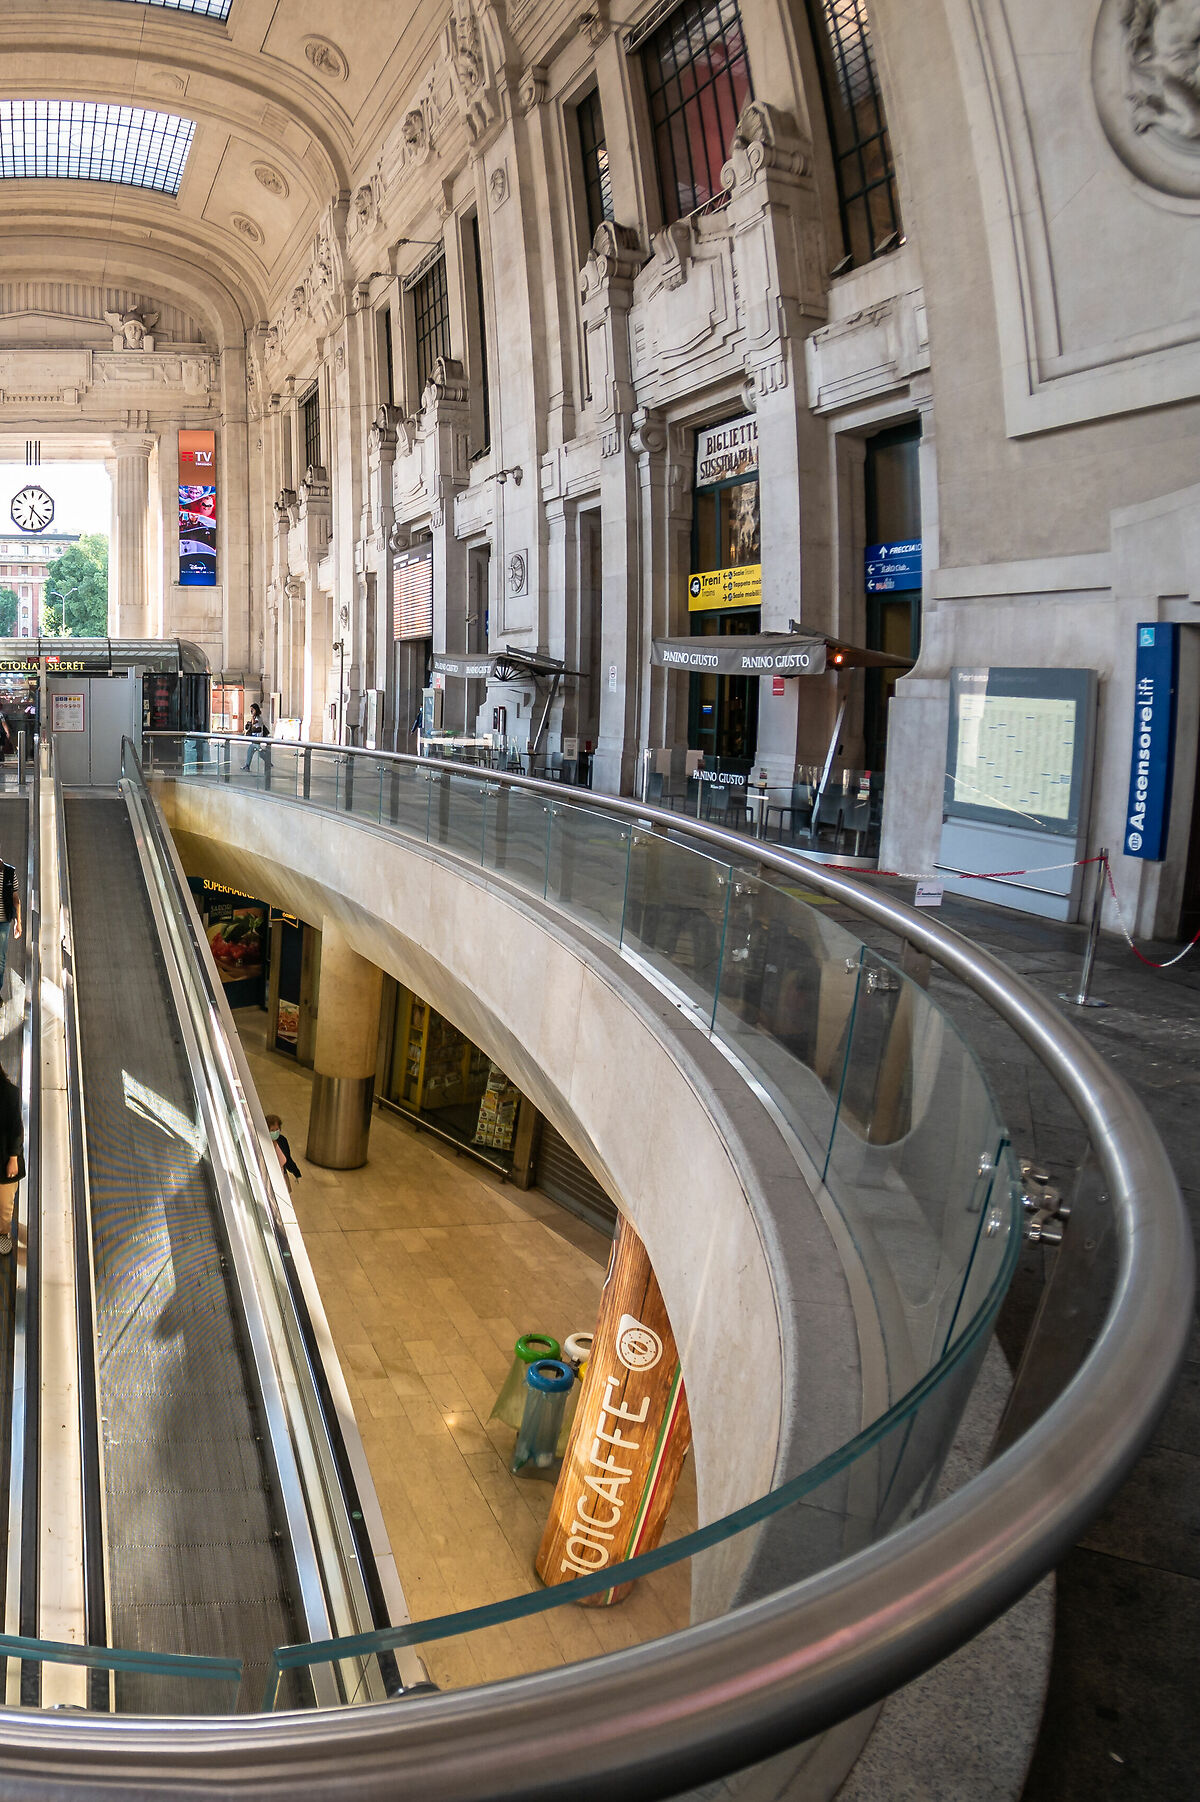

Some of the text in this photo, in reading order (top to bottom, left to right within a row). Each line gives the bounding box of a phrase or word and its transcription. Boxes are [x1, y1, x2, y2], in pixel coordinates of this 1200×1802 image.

[195, 451, 212, 462] TV
[701, 573, 721, 587] Treni
[663, 650, 719, 667] PANINO GIUSTO
[742, 654, 810, 668] PANINO GIUSTO
[692, 769, 745, 786] PANINO GIUSTO
